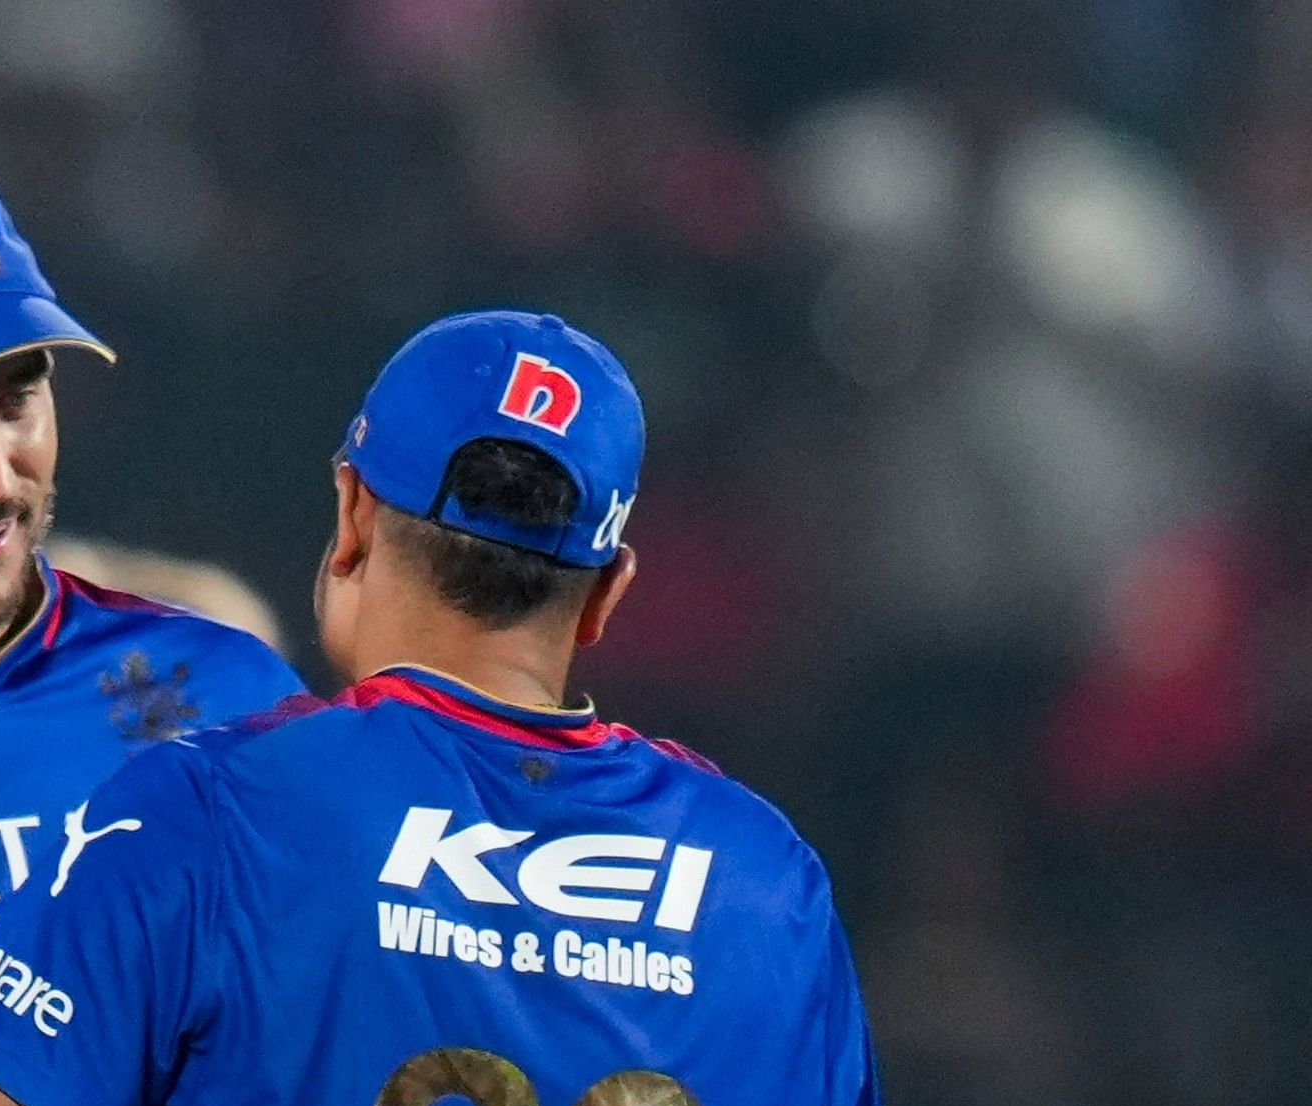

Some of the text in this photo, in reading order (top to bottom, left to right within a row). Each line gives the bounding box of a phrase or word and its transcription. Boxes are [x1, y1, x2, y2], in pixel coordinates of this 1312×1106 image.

[498, 352, 582, 437] n
[378, 806, 714, 932] KEI
[377, 901, 694, 996] Wires & Cables
